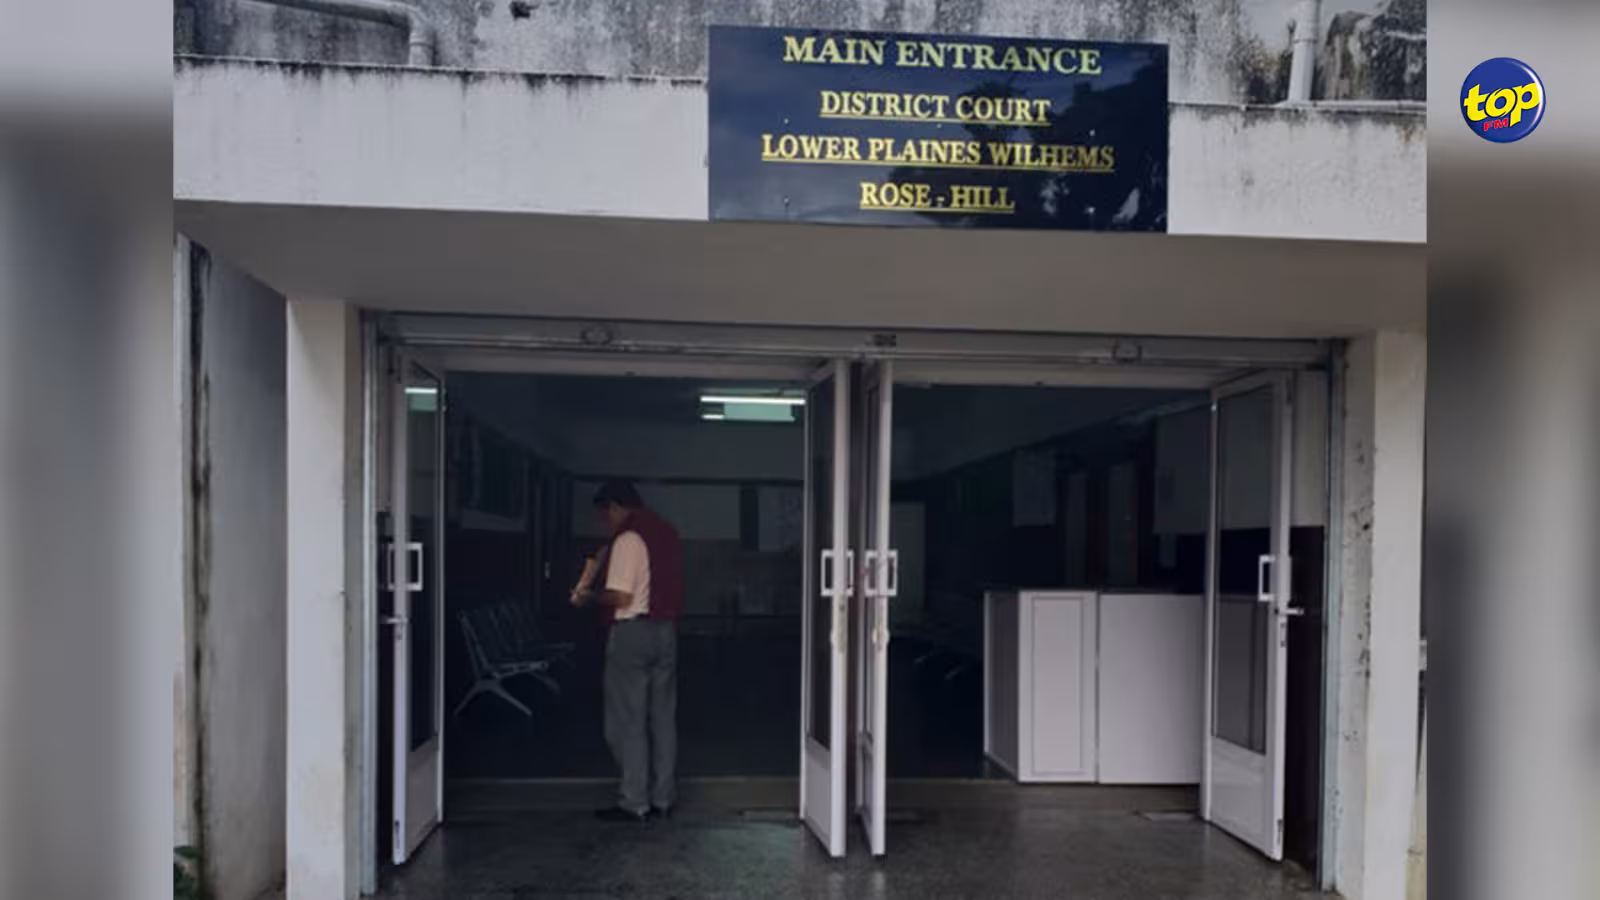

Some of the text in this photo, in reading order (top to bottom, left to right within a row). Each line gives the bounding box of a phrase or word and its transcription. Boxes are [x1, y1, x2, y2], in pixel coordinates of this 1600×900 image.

[783, 35, 1102, 75] MAIN ENTRANCE
[820, 91, 1052, 122] DISTRICT COURT
[761, 134, 1115, 169] LOWER PLAINES WILHEMS
[860, 182, 931, 207] ROSE
[950, 185, 1015, 210] HILL
